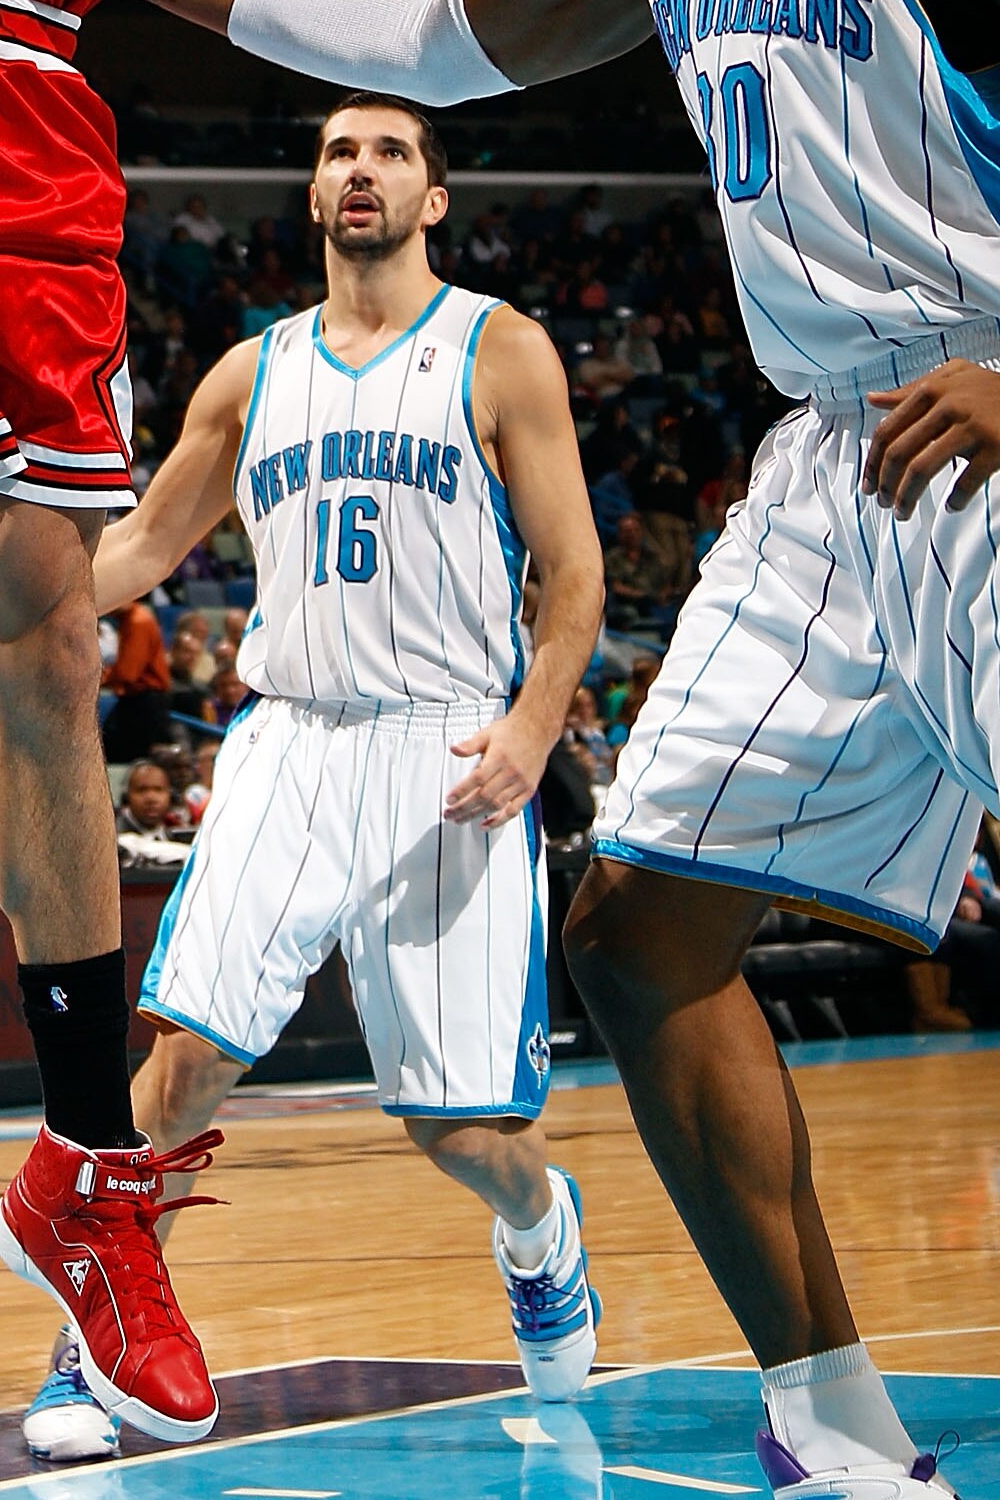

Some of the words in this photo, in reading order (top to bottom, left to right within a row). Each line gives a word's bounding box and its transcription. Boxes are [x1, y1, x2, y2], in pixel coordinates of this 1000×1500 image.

[249, 440, 313, 522] NEW
[321, 430, 463, 505] ORLEANS
[314, 495, 380, 588] 16
[106, 1175, 119, 1190] le
[119, 1180, 141, 1195] coq
